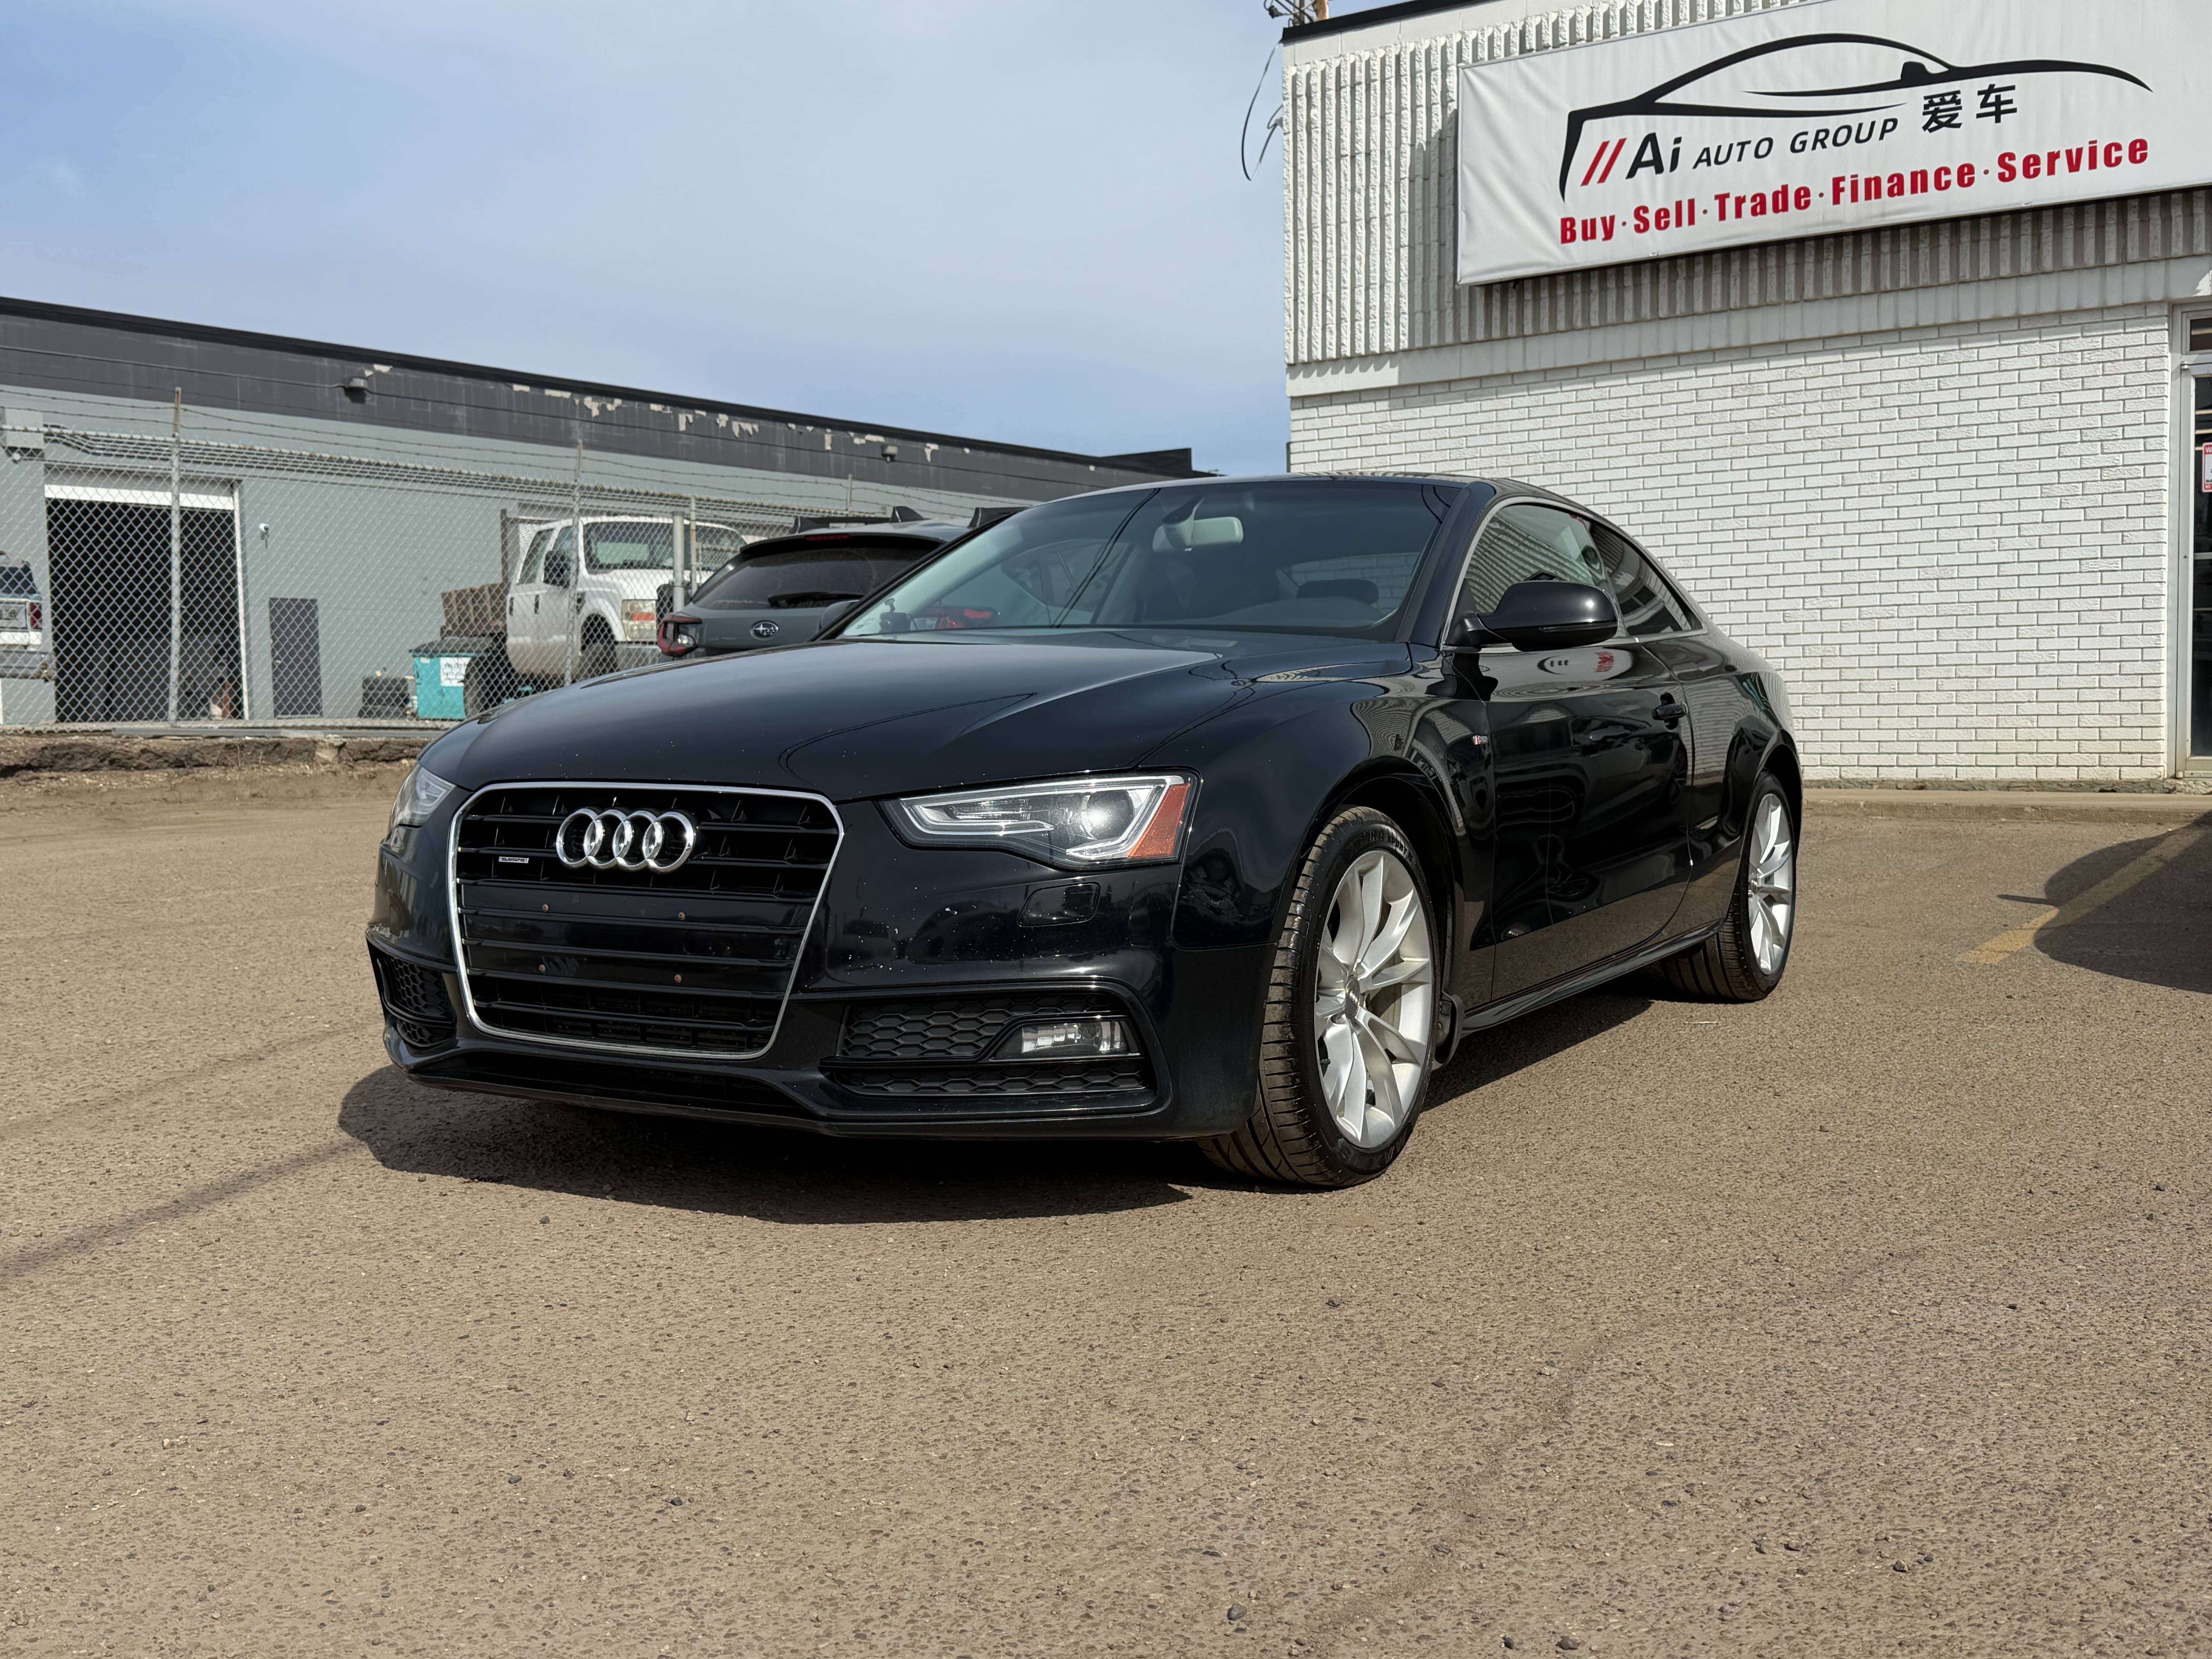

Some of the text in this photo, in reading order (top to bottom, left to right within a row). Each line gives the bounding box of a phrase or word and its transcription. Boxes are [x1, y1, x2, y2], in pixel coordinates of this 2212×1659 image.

[1692, 137, 1774, 169] AUTO
[1790, 118, 1898, 153] GROUP
[1922, 84, 2018, 133] 爱车
[1560, 139, 2148, 244] Buy Sell Trade Finance Service
